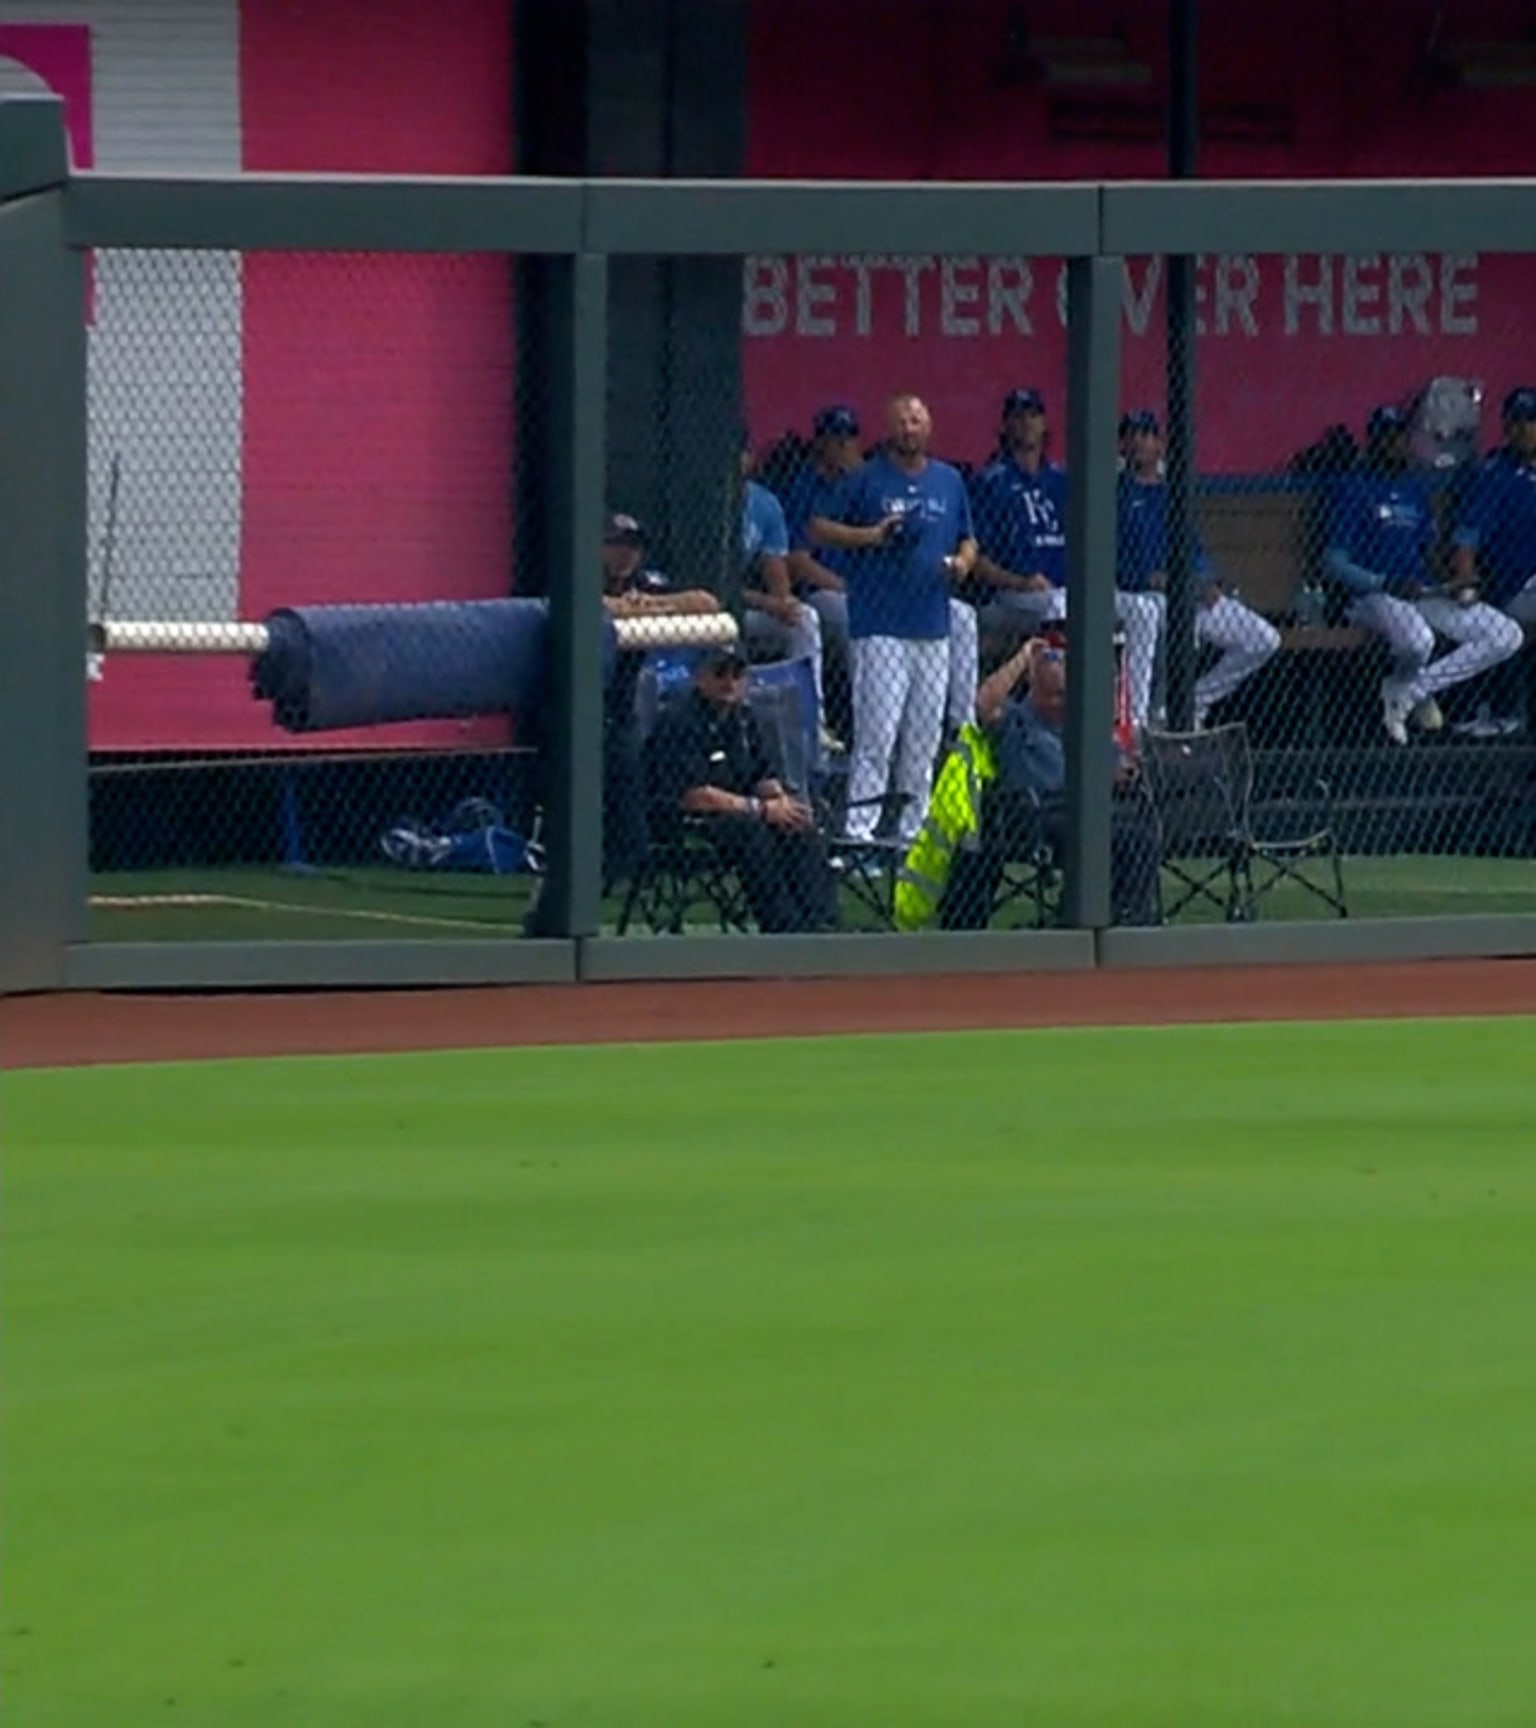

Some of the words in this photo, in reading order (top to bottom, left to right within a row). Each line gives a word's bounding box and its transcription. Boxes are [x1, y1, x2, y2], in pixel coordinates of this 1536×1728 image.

[742, 253, 1033, 337] BETTER
[1056, 253, 1260, 337] VR
[1284, 253, 1479, 337] HERE
